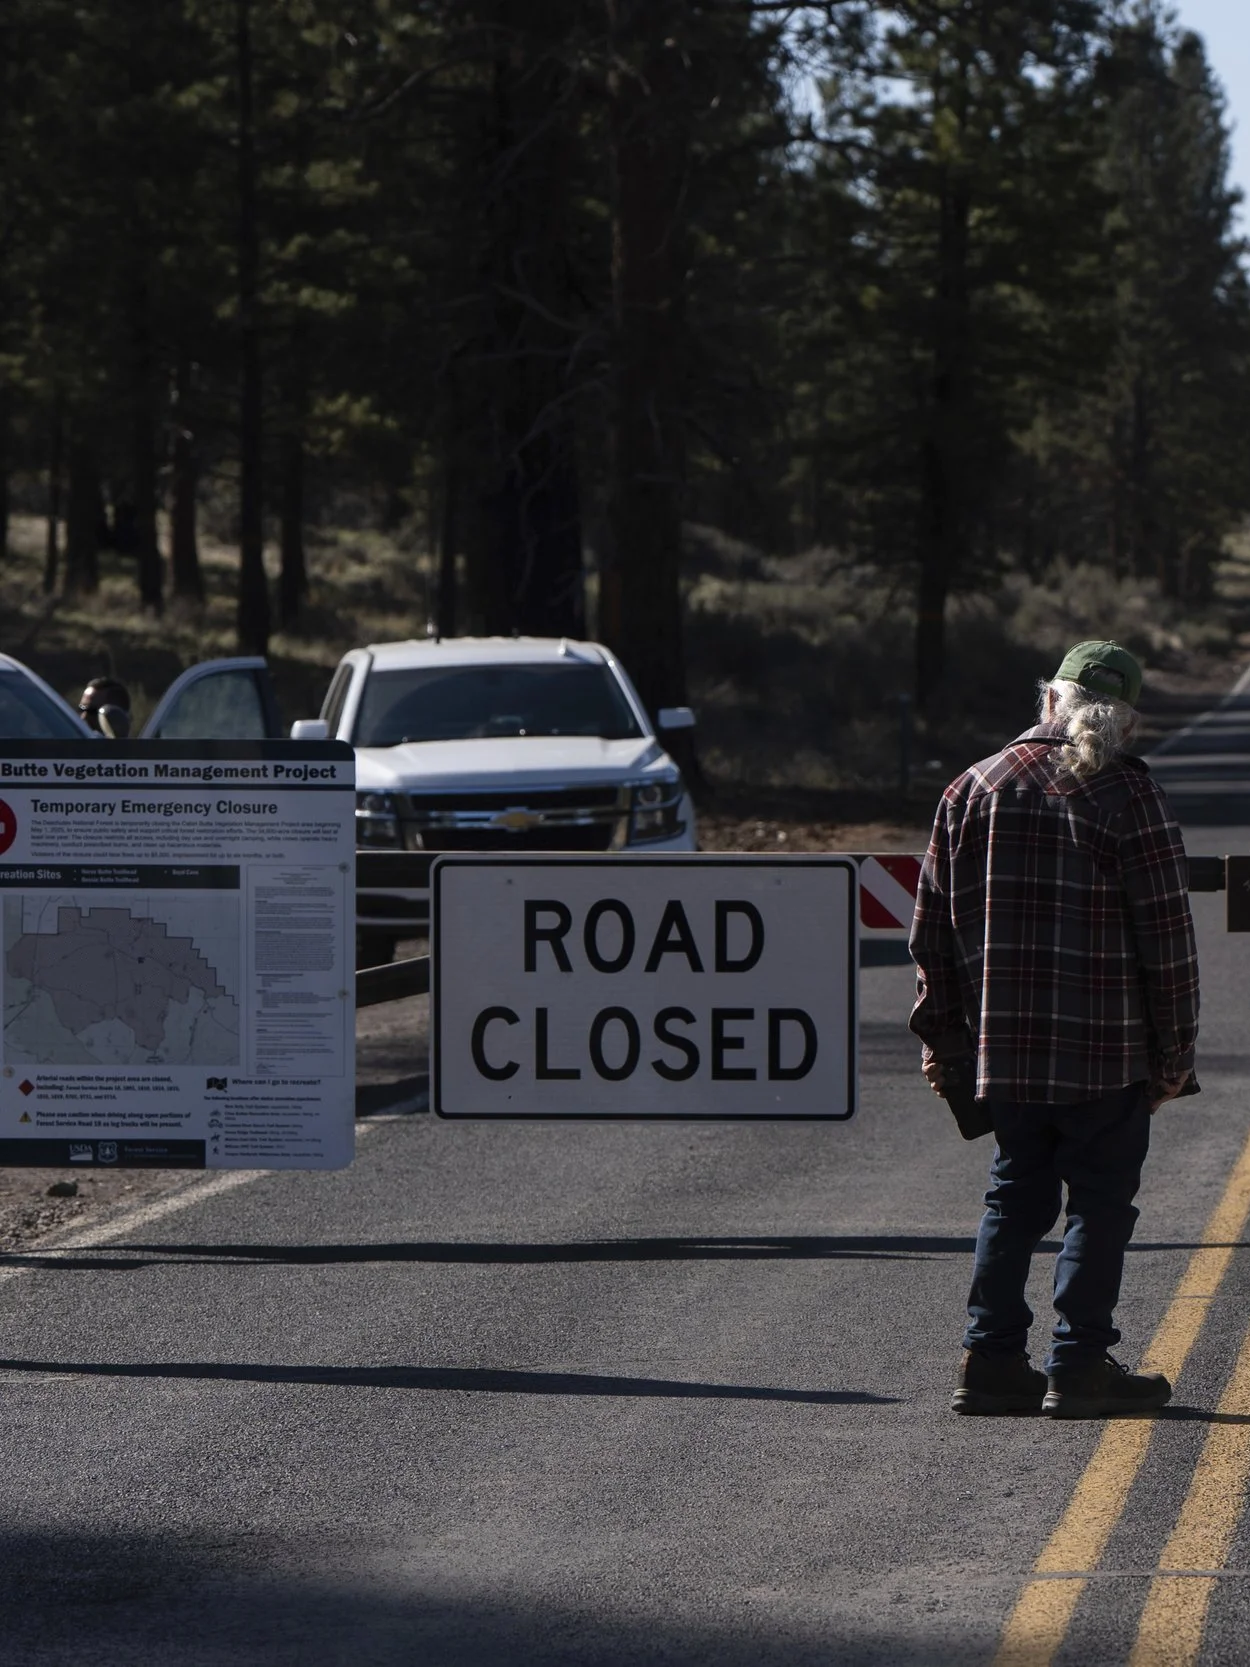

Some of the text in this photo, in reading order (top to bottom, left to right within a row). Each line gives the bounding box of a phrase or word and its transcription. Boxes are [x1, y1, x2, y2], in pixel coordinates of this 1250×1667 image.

[1, 763, 337, 781] Butte Vegetation Management Project
[31, 799, 278, 817] Temporary Emergency Closure
[36, 869, 62, 879] Sites
[524, 898, 765, 974] ROAD
[471, 1005, 818, 1081] CLOSED
